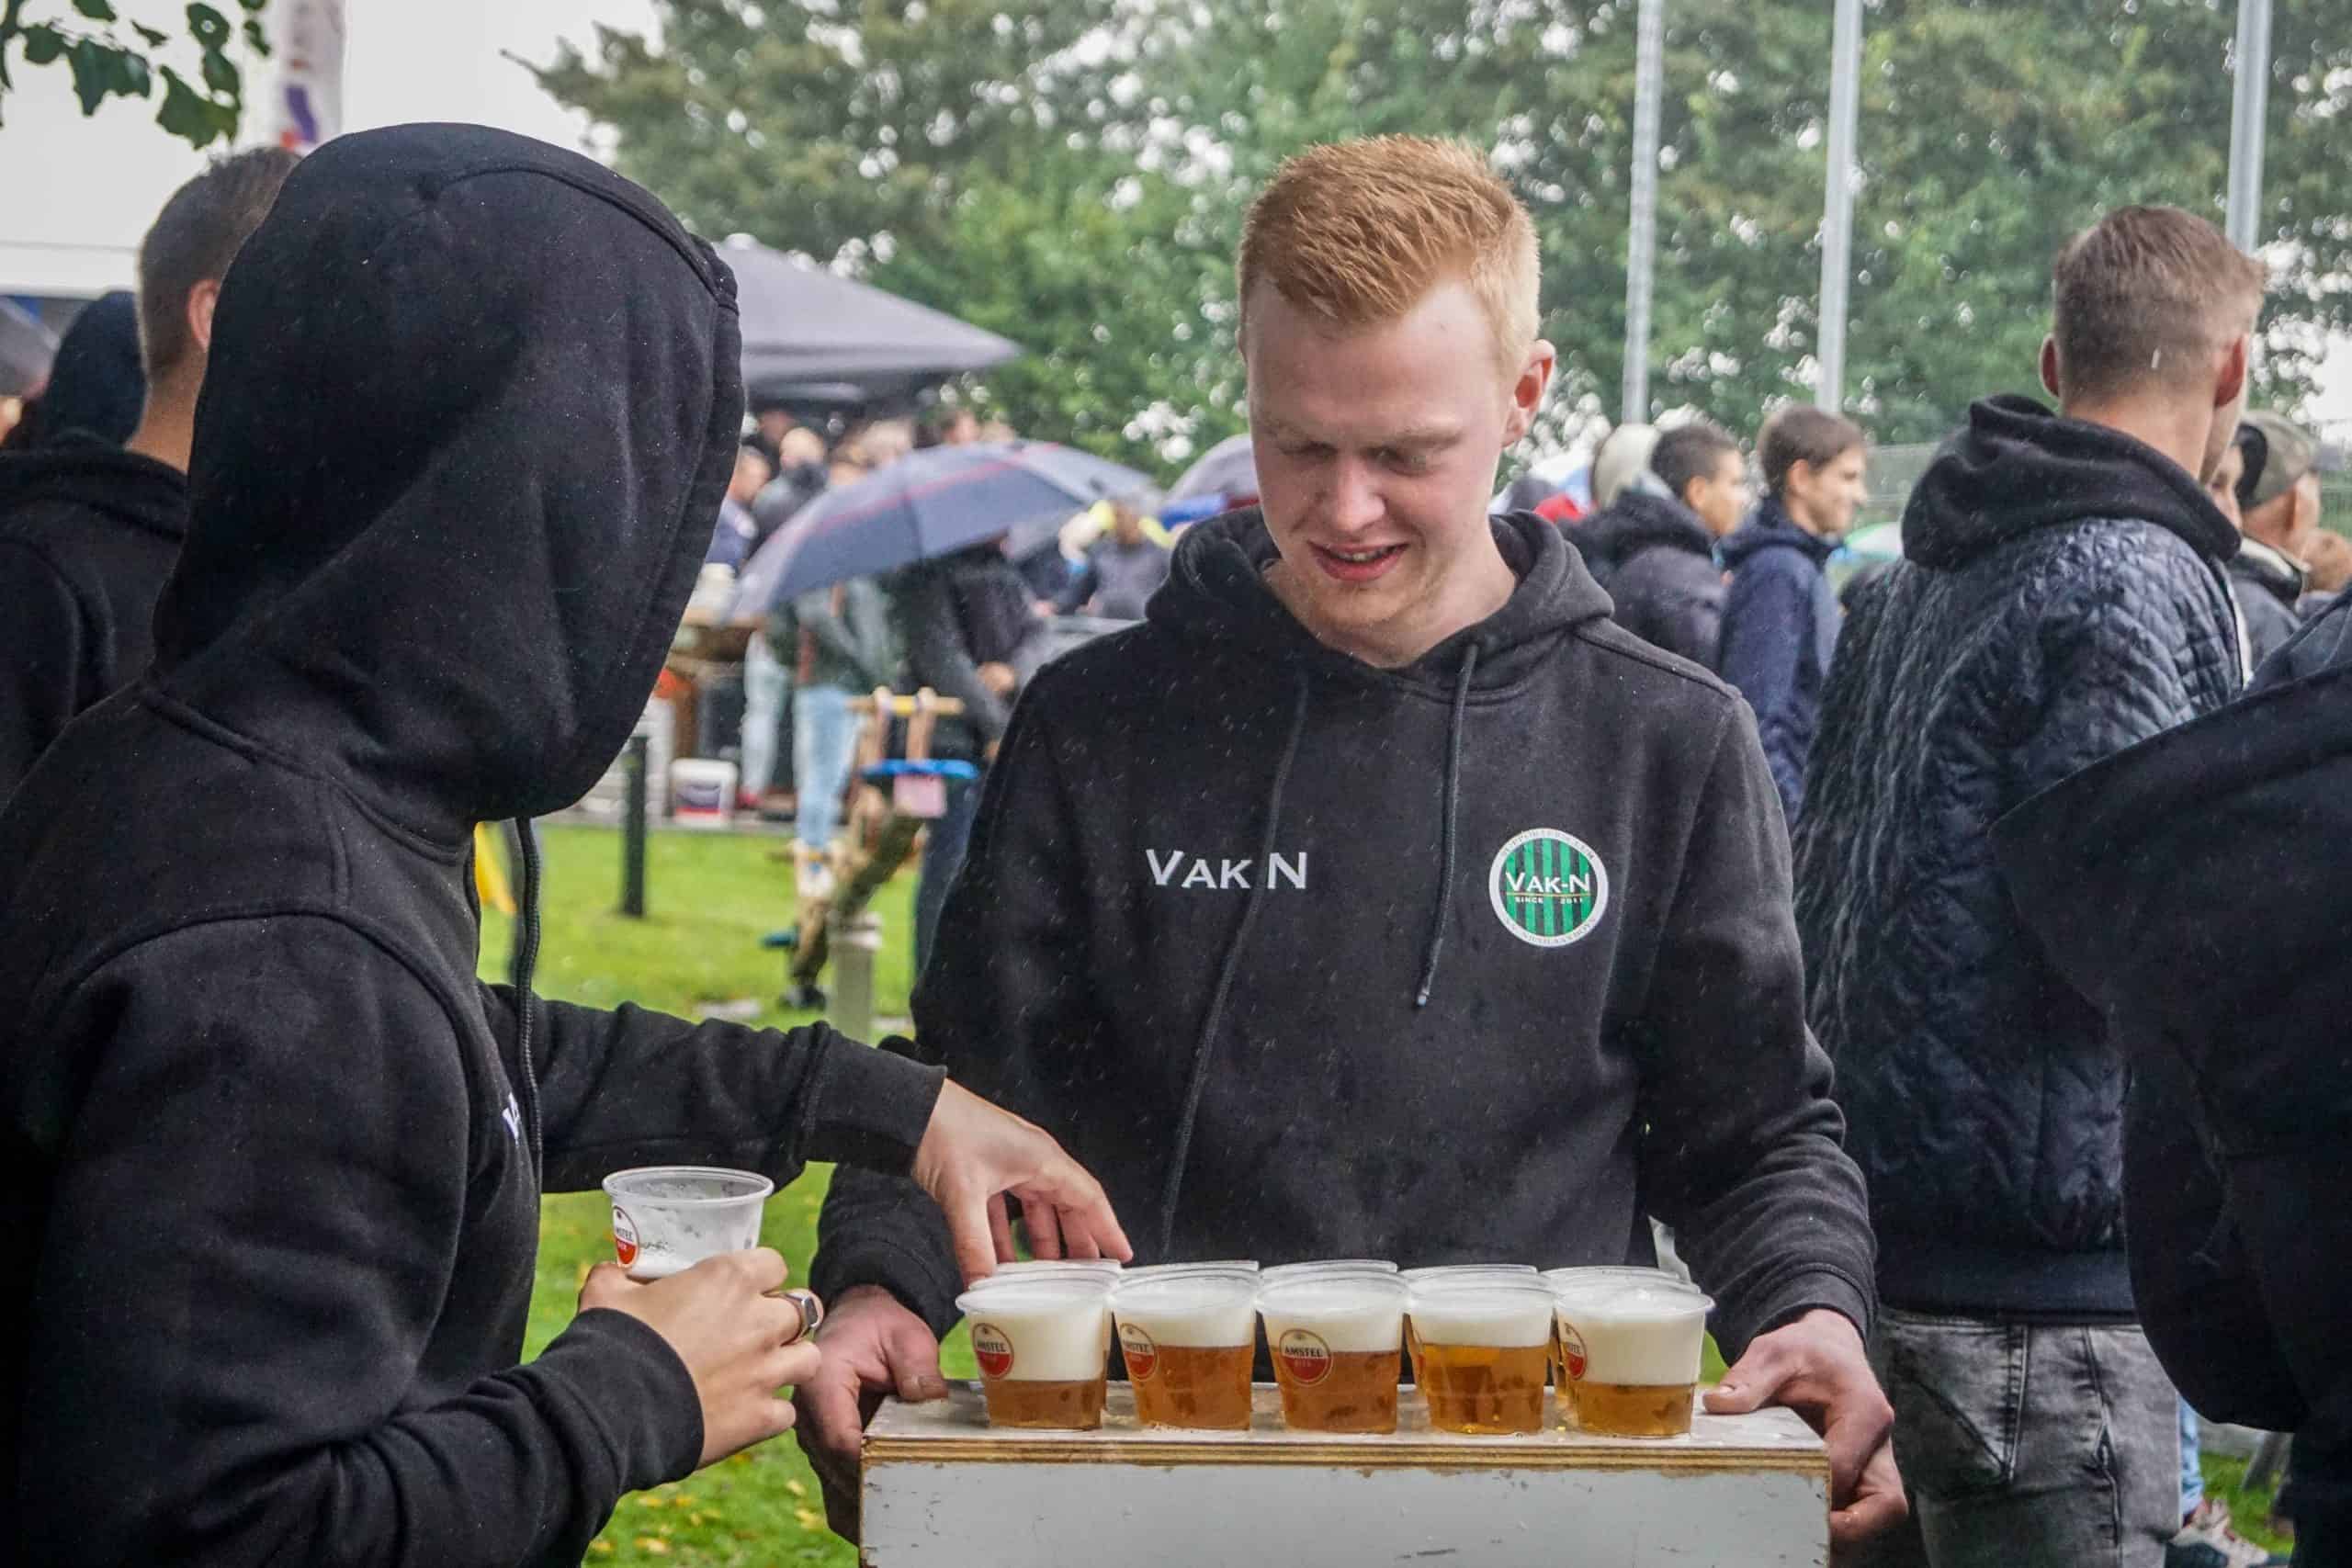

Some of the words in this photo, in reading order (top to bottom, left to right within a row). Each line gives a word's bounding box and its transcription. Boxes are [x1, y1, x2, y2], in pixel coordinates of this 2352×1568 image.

[1267, 851, 1307, 890] N
[1514, 897, 1544, 905] SINCE
[1284, 1346, 1324, 1358] AMSTEL
